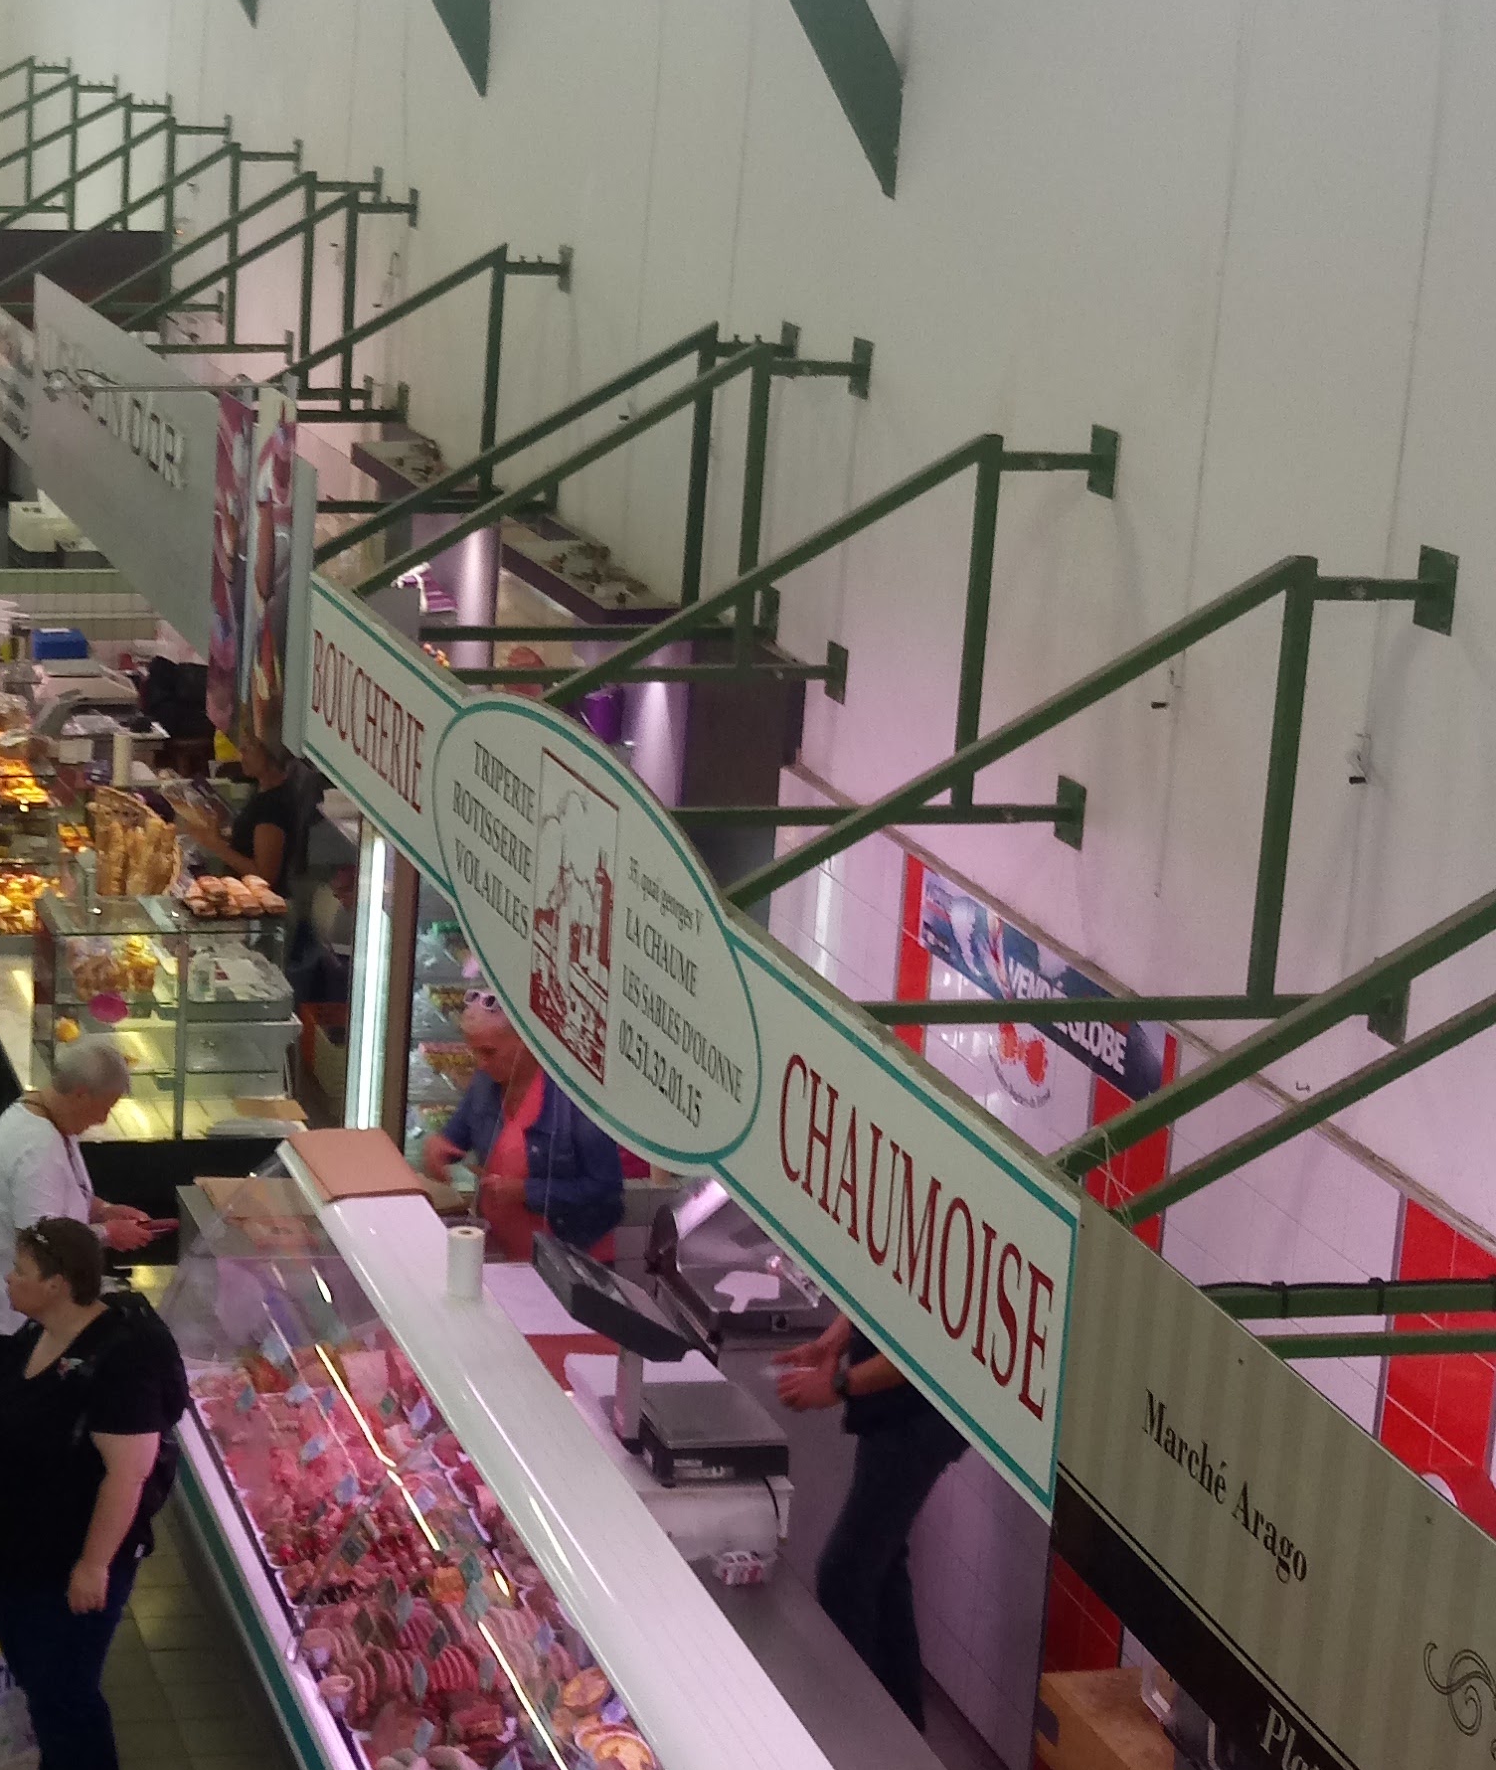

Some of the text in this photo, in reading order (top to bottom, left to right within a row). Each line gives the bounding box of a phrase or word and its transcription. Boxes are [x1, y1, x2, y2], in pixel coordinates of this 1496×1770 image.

[312, 628, 425, 814] BOUCHERIE
[453, 779, 534, 885] ROTISSERIE
[474, 738, 536, 826] TRIPERIE
[455, 836, 530, 941] VOLAILLES
[625, 906, 700, 998] LA CHAUME
[618, 1018, 703, 1129] 02.51.32.01.15
[622, 963, 744, 1105] LES SABLES D'OLONNE
[779, 1053, 1055, 1422] CHAUMOISE
[1141, 1388, 1308, 1584] Marché Arago
